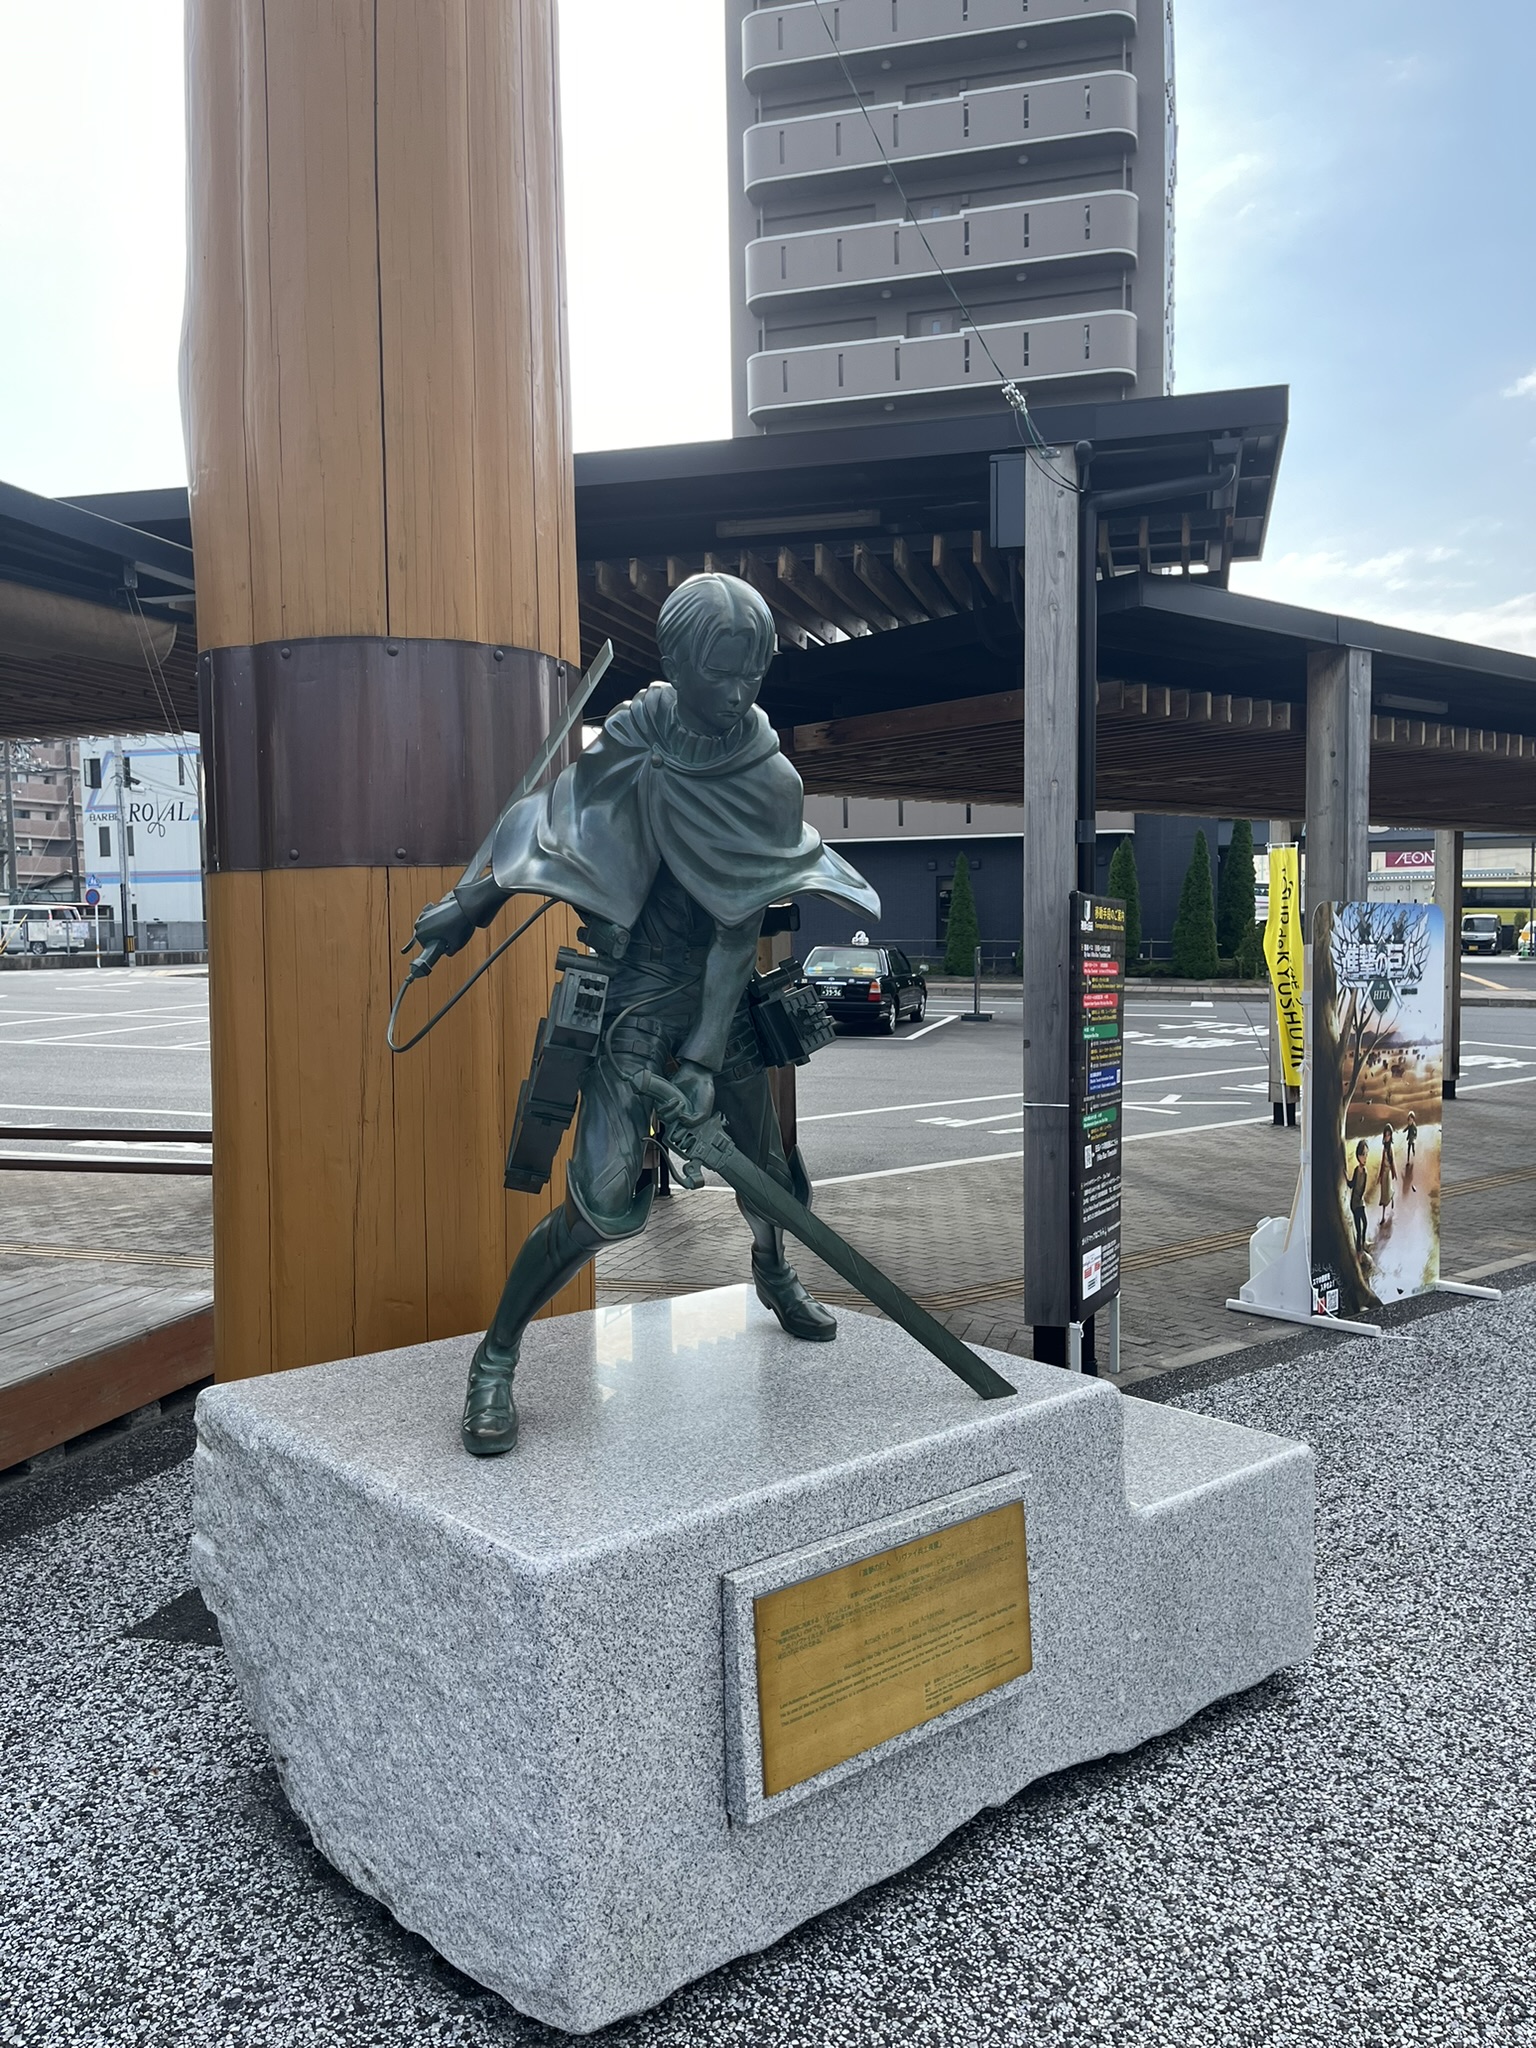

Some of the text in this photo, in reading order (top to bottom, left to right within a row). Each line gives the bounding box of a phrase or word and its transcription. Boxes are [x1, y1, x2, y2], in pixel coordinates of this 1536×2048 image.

[129, 800, 190, 833] ROYAL
[1341, 942, 1421, 980] 進撃の巨人
[1373, 990, 1390, 1000] HITA
